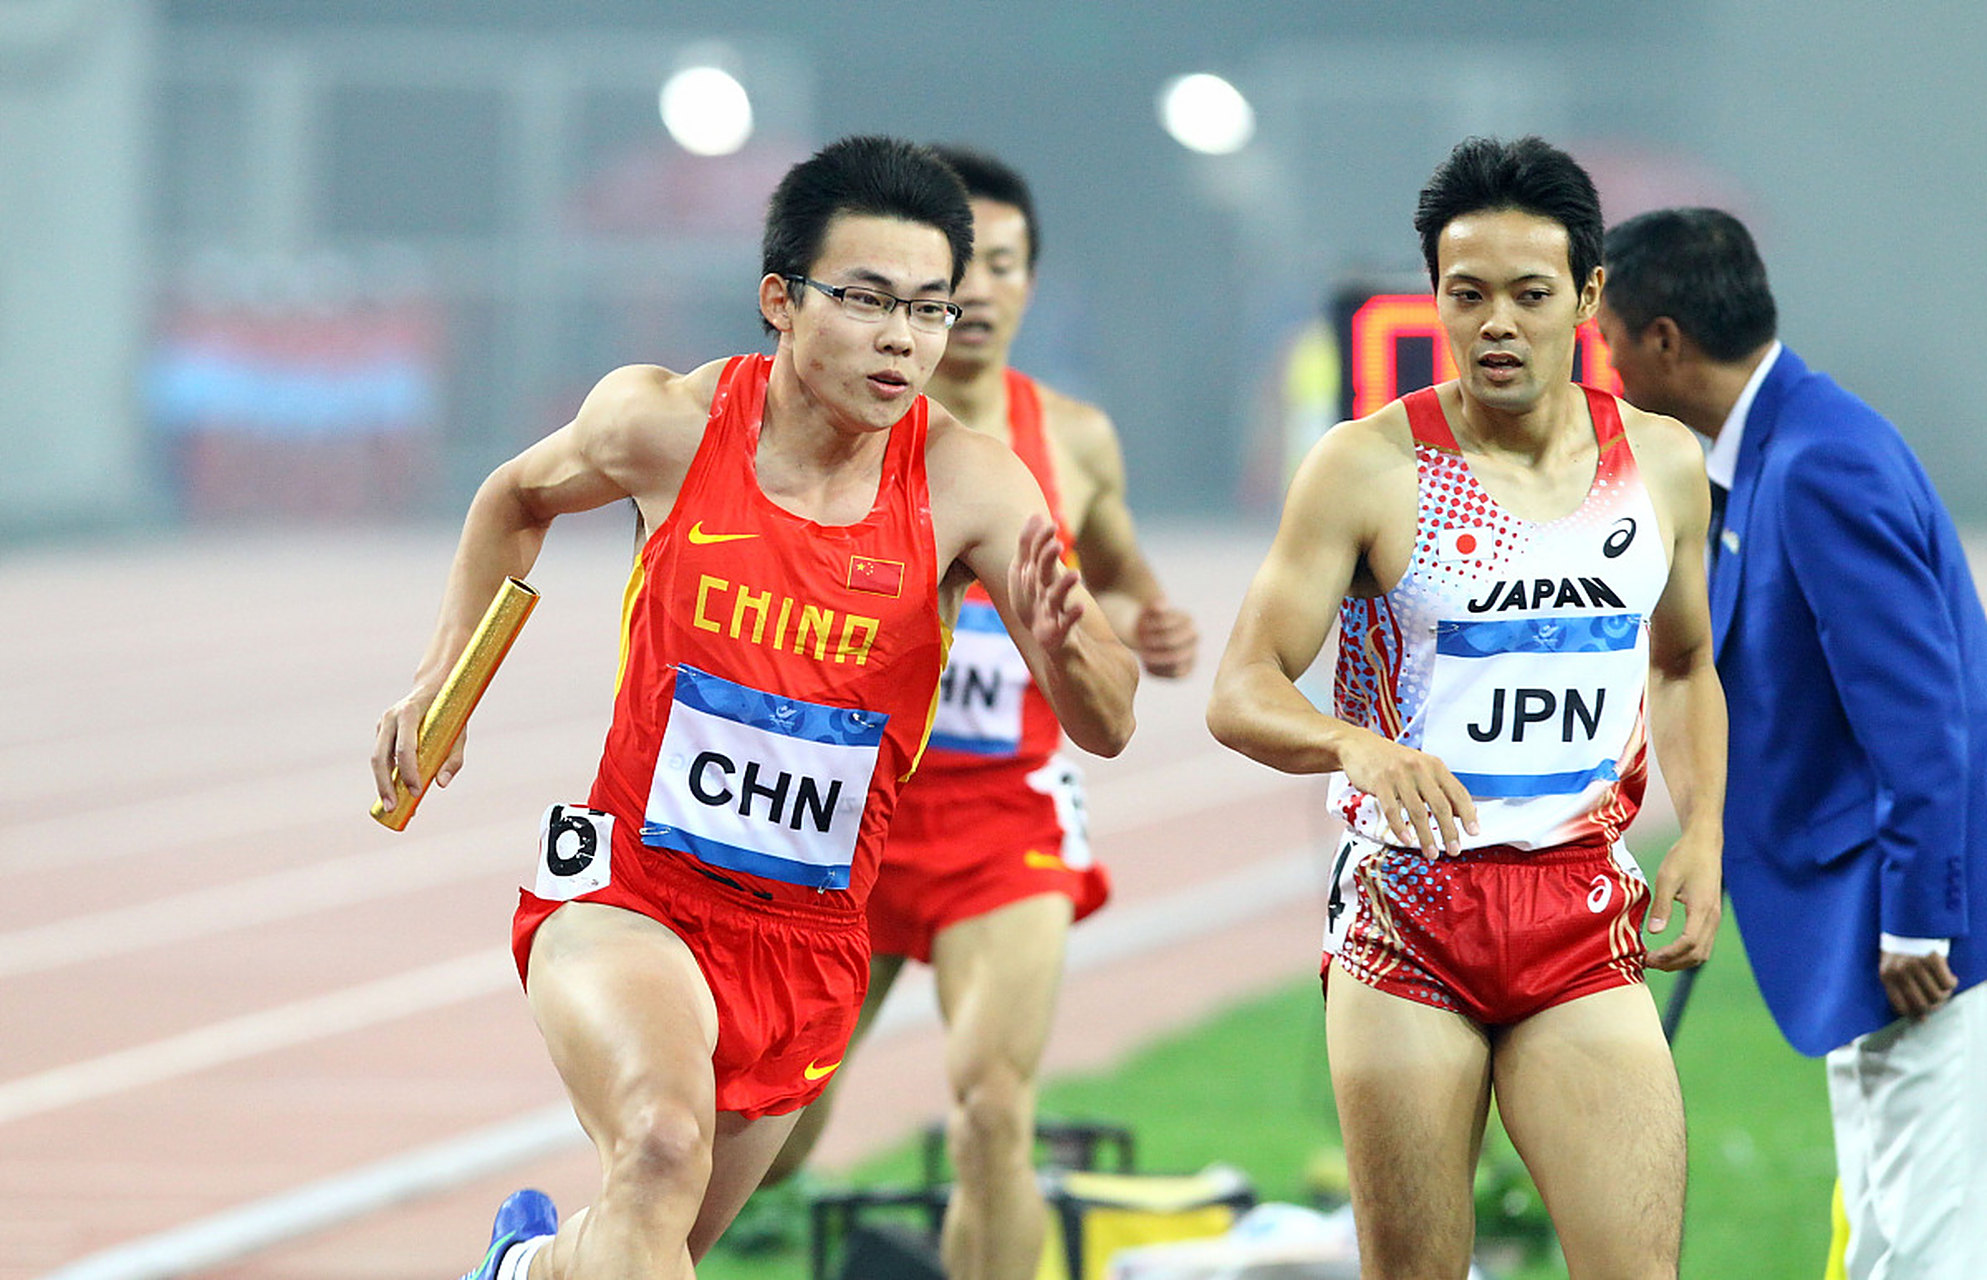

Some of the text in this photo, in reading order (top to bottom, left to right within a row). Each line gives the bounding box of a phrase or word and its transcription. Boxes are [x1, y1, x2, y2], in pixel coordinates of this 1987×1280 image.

[693, 573, 881, 666] CHINA
[1467, 577, 1628, 614] JAPAN
[1467, 688, 1606, 743] JPN
[688, 751, 844, 834] CHN
